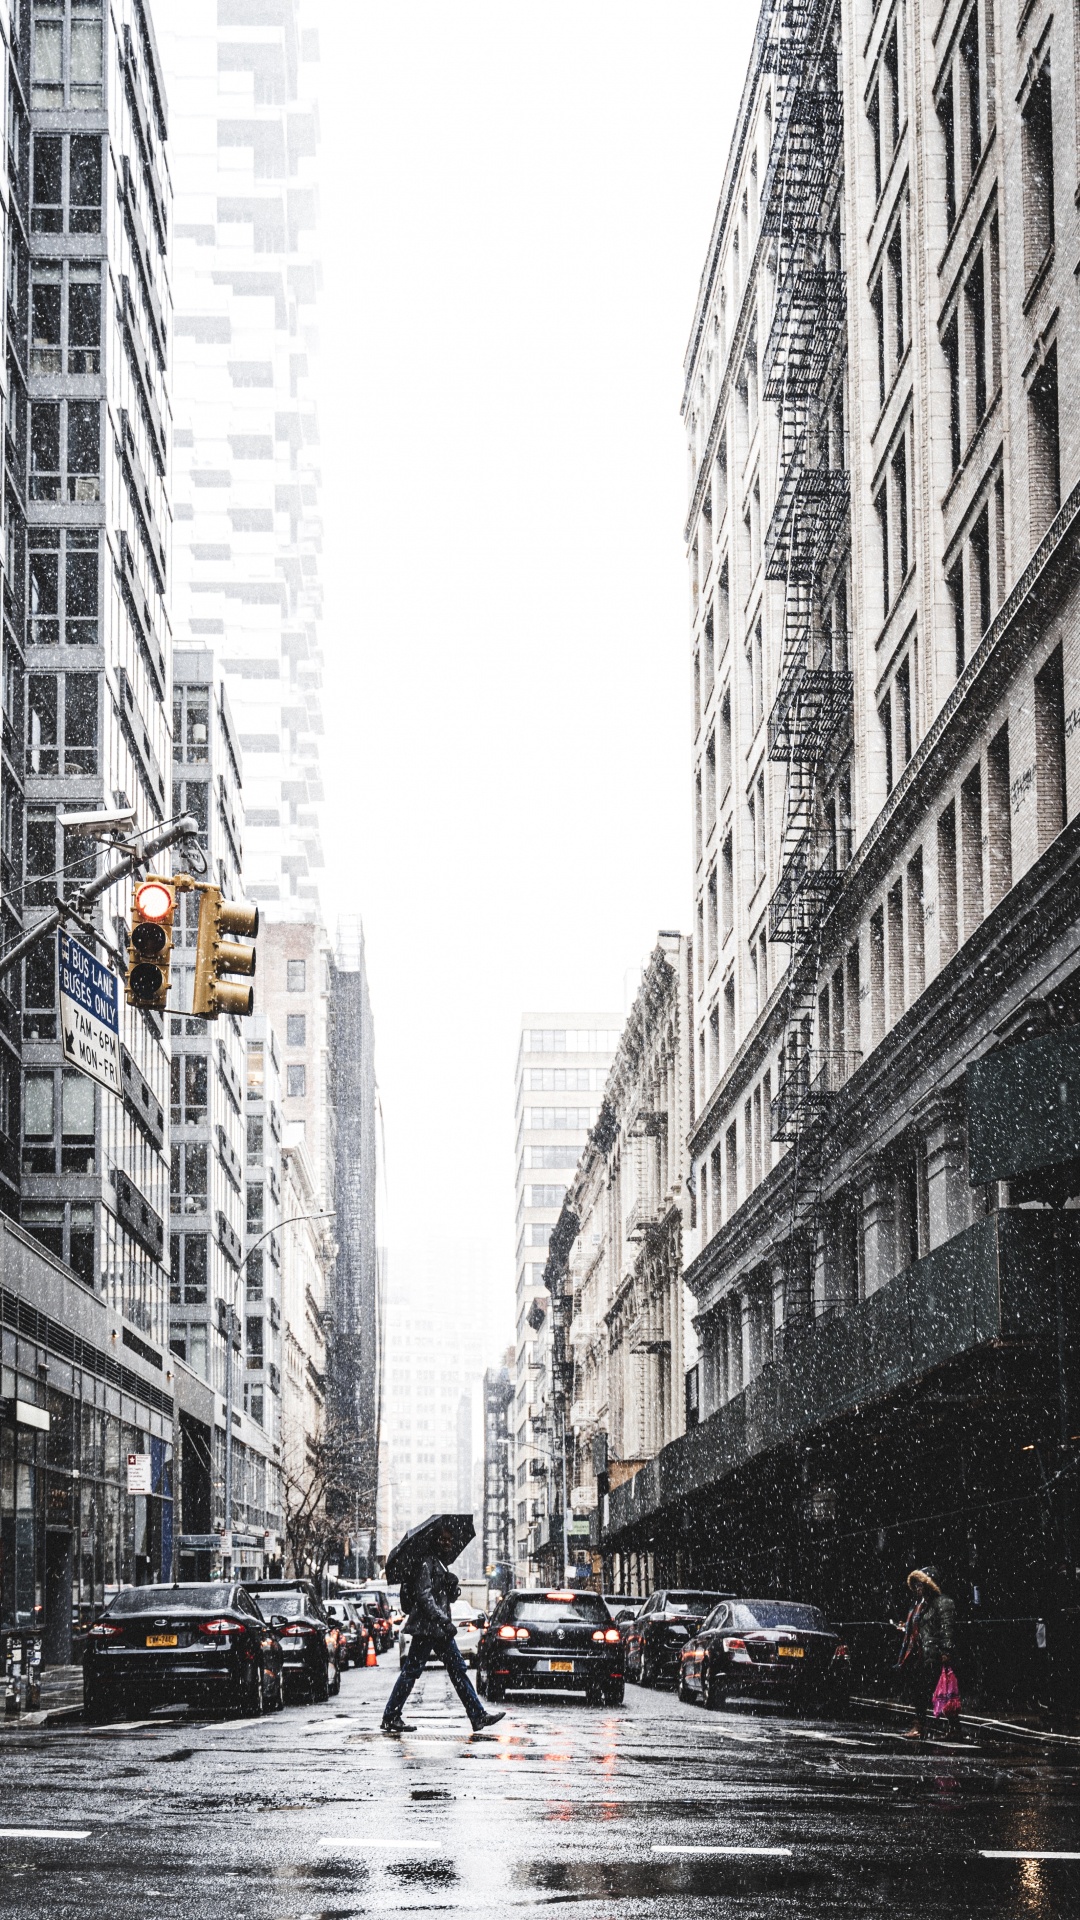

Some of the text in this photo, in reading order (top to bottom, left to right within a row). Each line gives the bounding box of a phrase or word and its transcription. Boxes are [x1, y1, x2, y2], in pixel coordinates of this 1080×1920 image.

[63, 968, 116, 1026] BUSES ONLY
[72, 947, 114, 1000] BUS LANE
